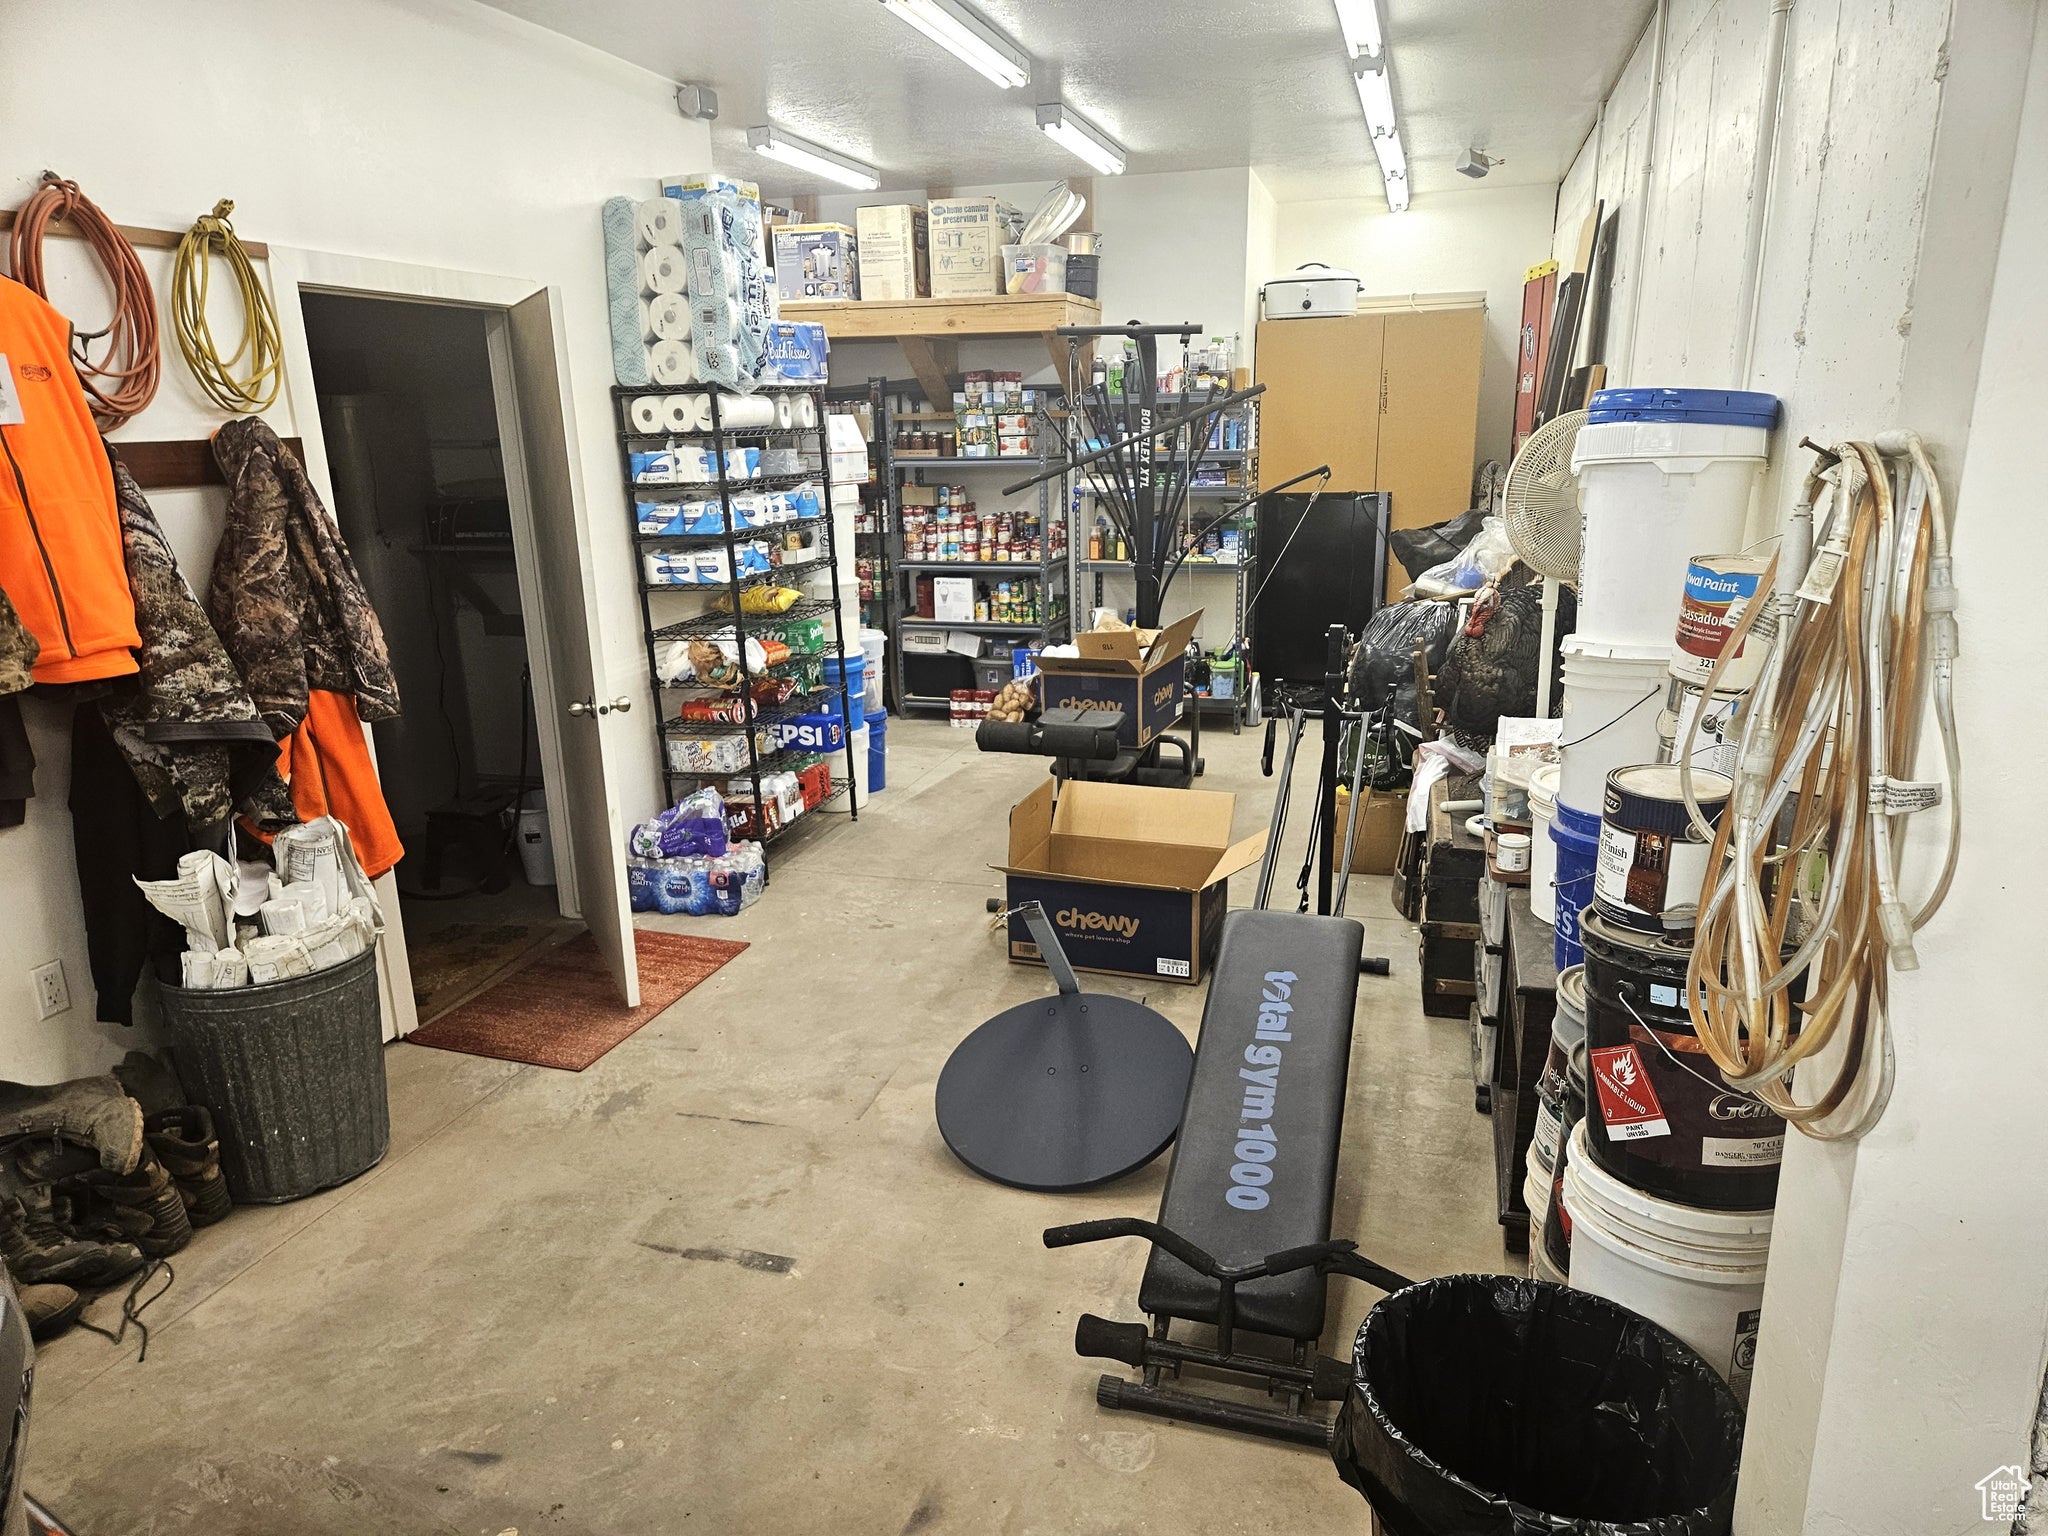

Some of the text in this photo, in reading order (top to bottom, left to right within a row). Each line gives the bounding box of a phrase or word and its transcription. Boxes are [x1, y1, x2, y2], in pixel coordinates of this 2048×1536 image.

[946, 204, 989, 214] home canning
[943, 214, 977, 225] preserving
[980, 213, 989, 222] kit
[768, 340, 811, 360] Bath Tissue
[1139, 467, 1151, 489] XTL
[1703, 577, 1740, 593] Paint
[809, 623, 825, 641] Sprite
[1693, 625, 1706, 634] Acrylic
[1705, 628, 1722, 636] Enamel
[1154, 682, 1174, 706] chewy
[1604, 839, 1628, 860] Finish
[1055, 907, 1140, 938] chewy
[1095, 935, 1115, 943] lovers
[1116, 937, 1131, 945] shop
[1225, 970, 1299, 1211] total gym 1000
[1596, 1066, 1646, 1115] FLAMMABLE LIQUID
[1607, 1108, 1613, 1118] 3
[1708, 1093, 1777, 1121] Gem
[1626, 1123, 1644, 1132] PAINT
[1626, 1130, 1649, 1138] UN1263
